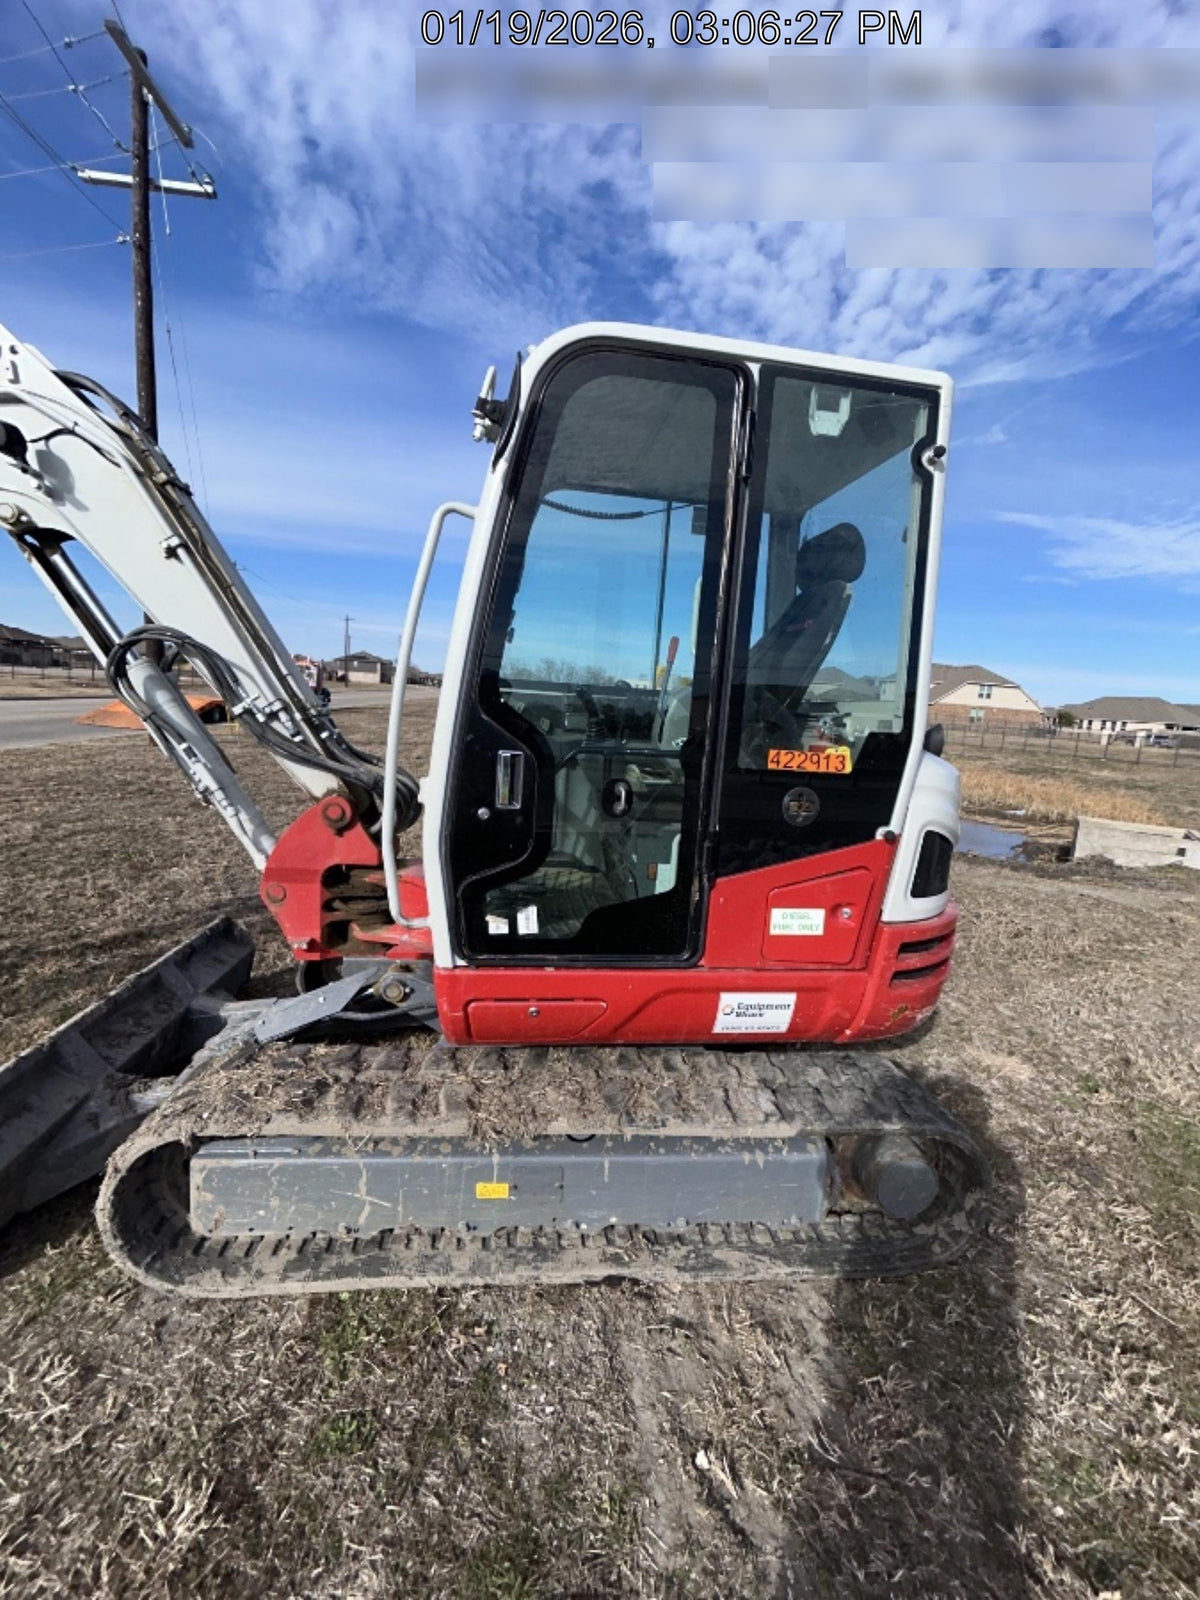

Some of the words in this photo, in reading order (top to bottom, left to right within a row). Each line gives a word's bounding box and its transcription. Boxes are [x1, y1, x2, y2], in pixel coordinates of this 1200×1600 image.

[769, 751, 846, 772] 422913
[798, 923, 821, 932] ONLY
[736, 1001, 791, 1012] Equipment
